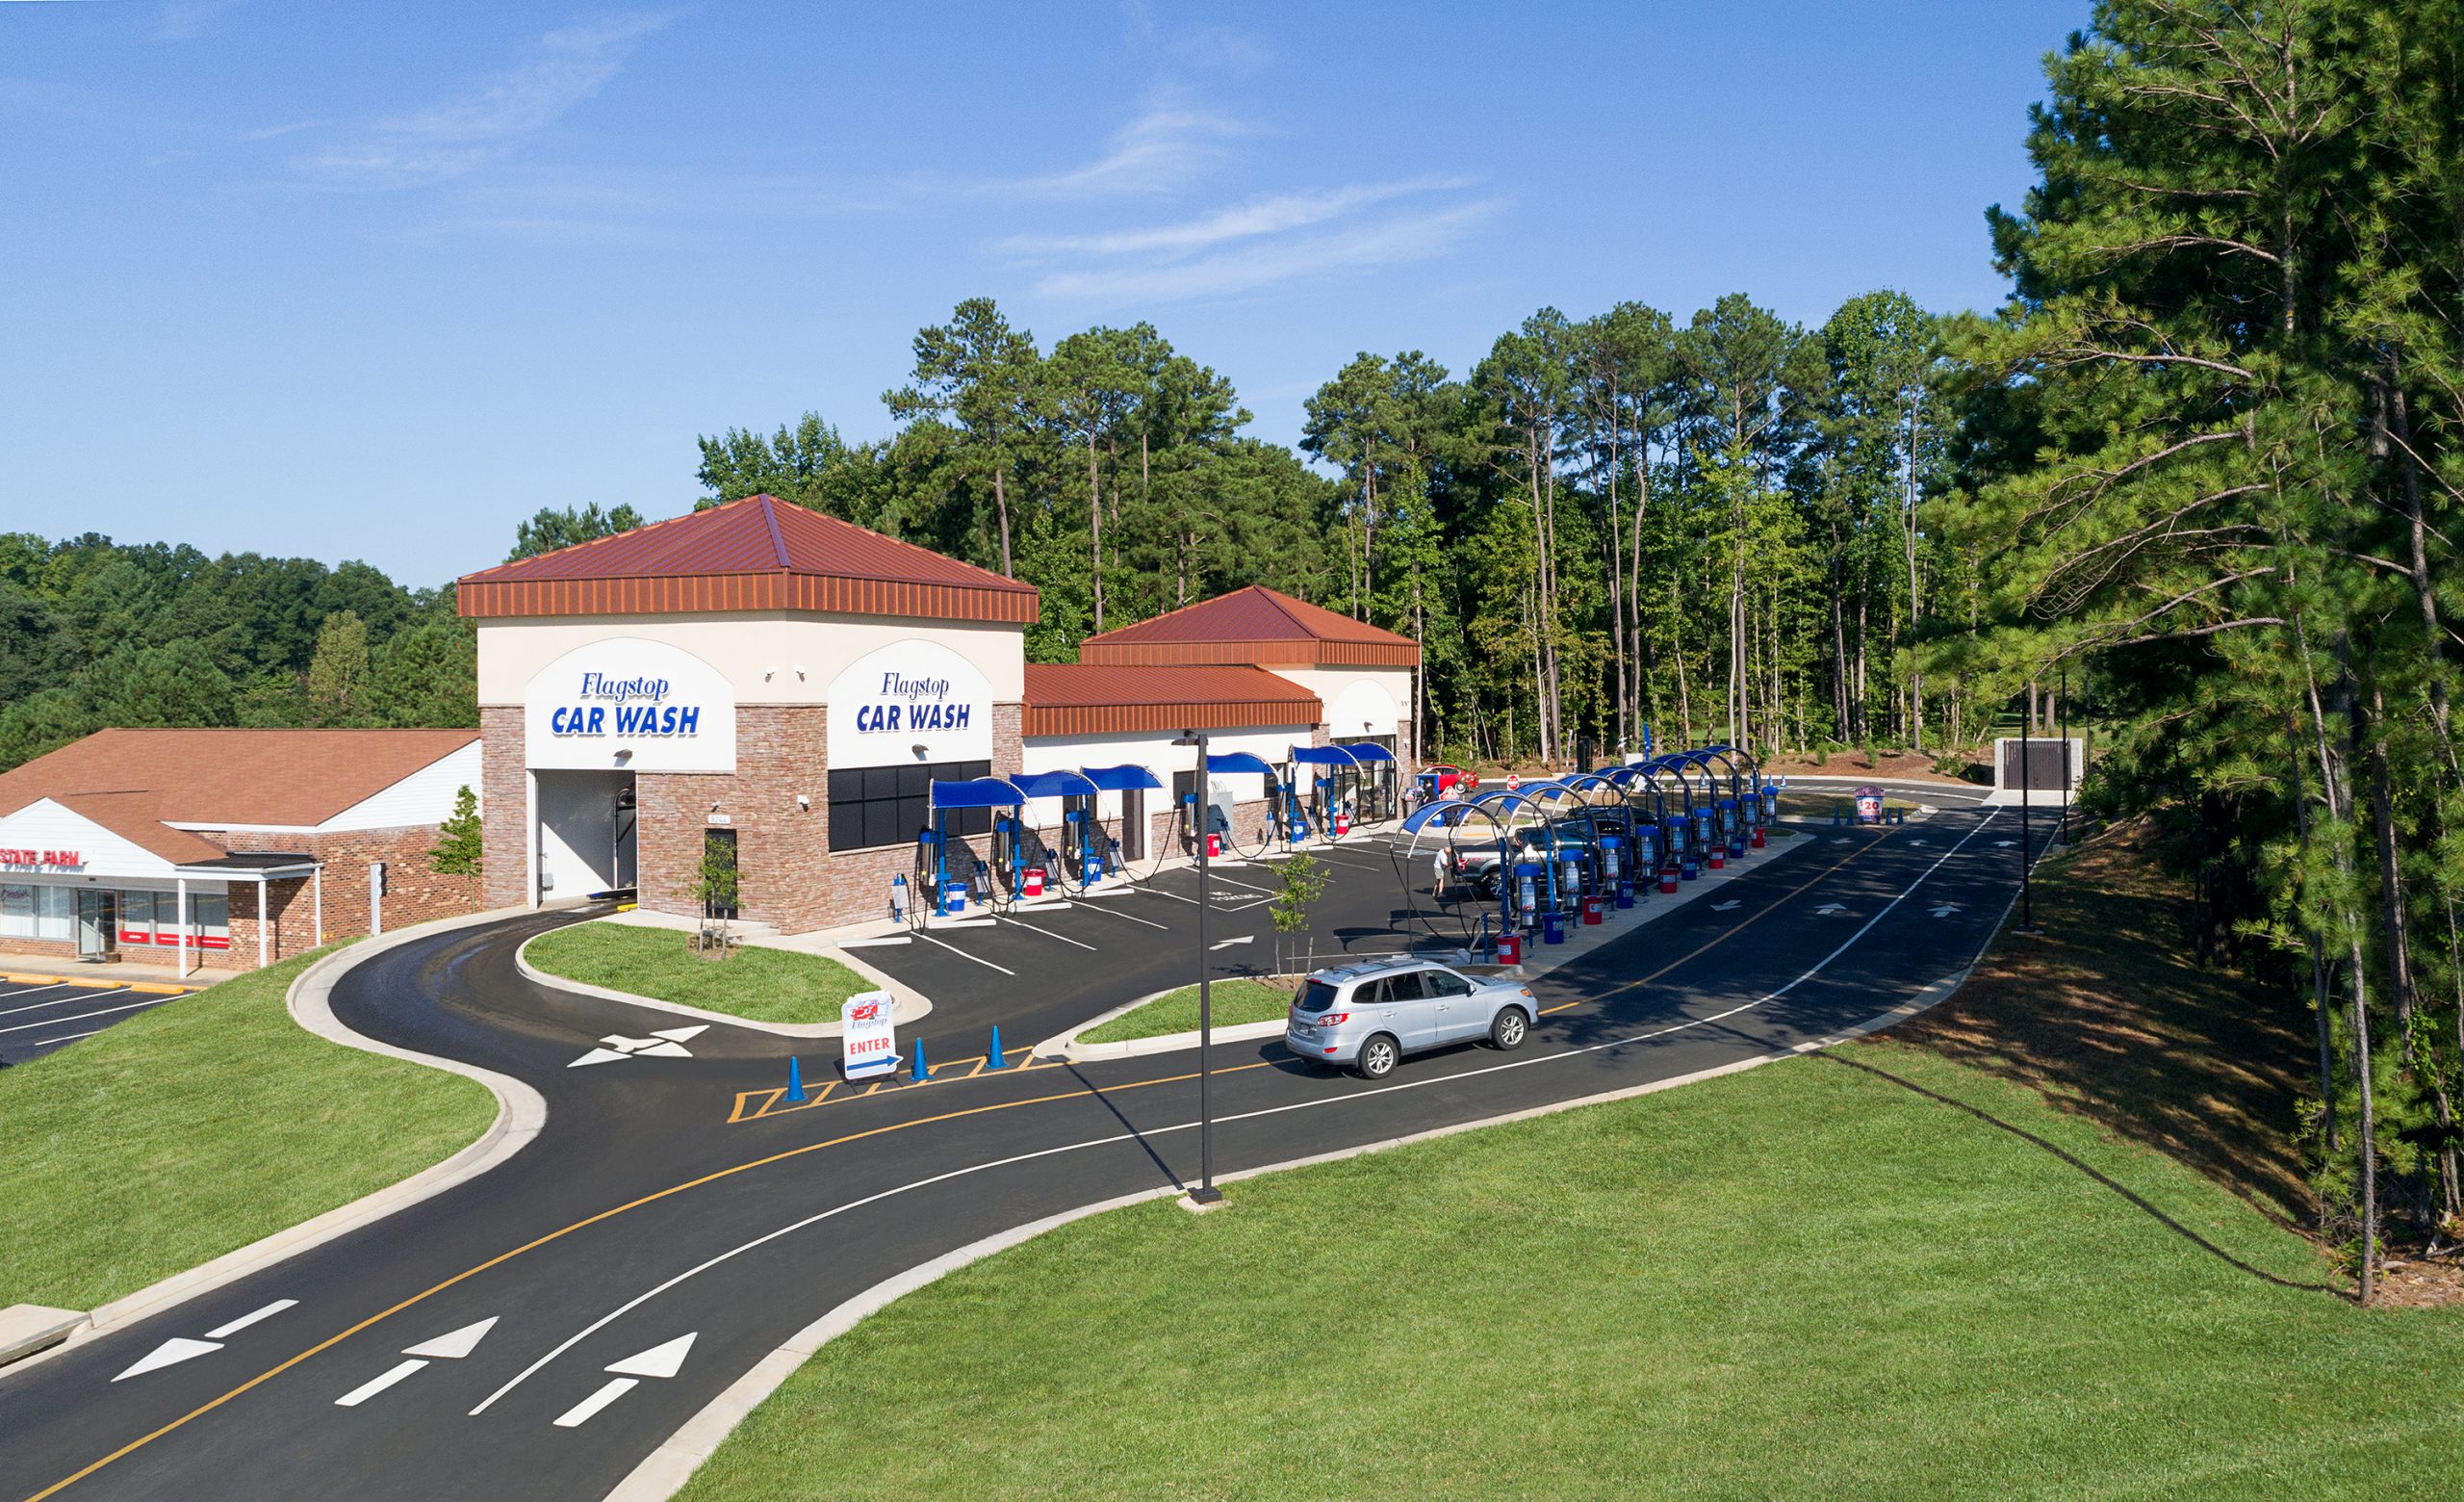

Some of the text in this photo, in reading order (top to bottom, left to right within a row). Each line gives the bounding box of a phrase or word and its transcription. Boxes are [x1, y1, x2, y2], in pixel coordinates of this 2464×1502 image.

[580, 672, 669, 702] Flagstop
[882, 672, 949, 701] Flagstop
[551, 706, 701, 734] CAR WASH
[857, 704, 970, 732] CAR WASH
[0, 848, 79, 867] STATE FARM
[850, 1037, 890, 1055] ENTER
